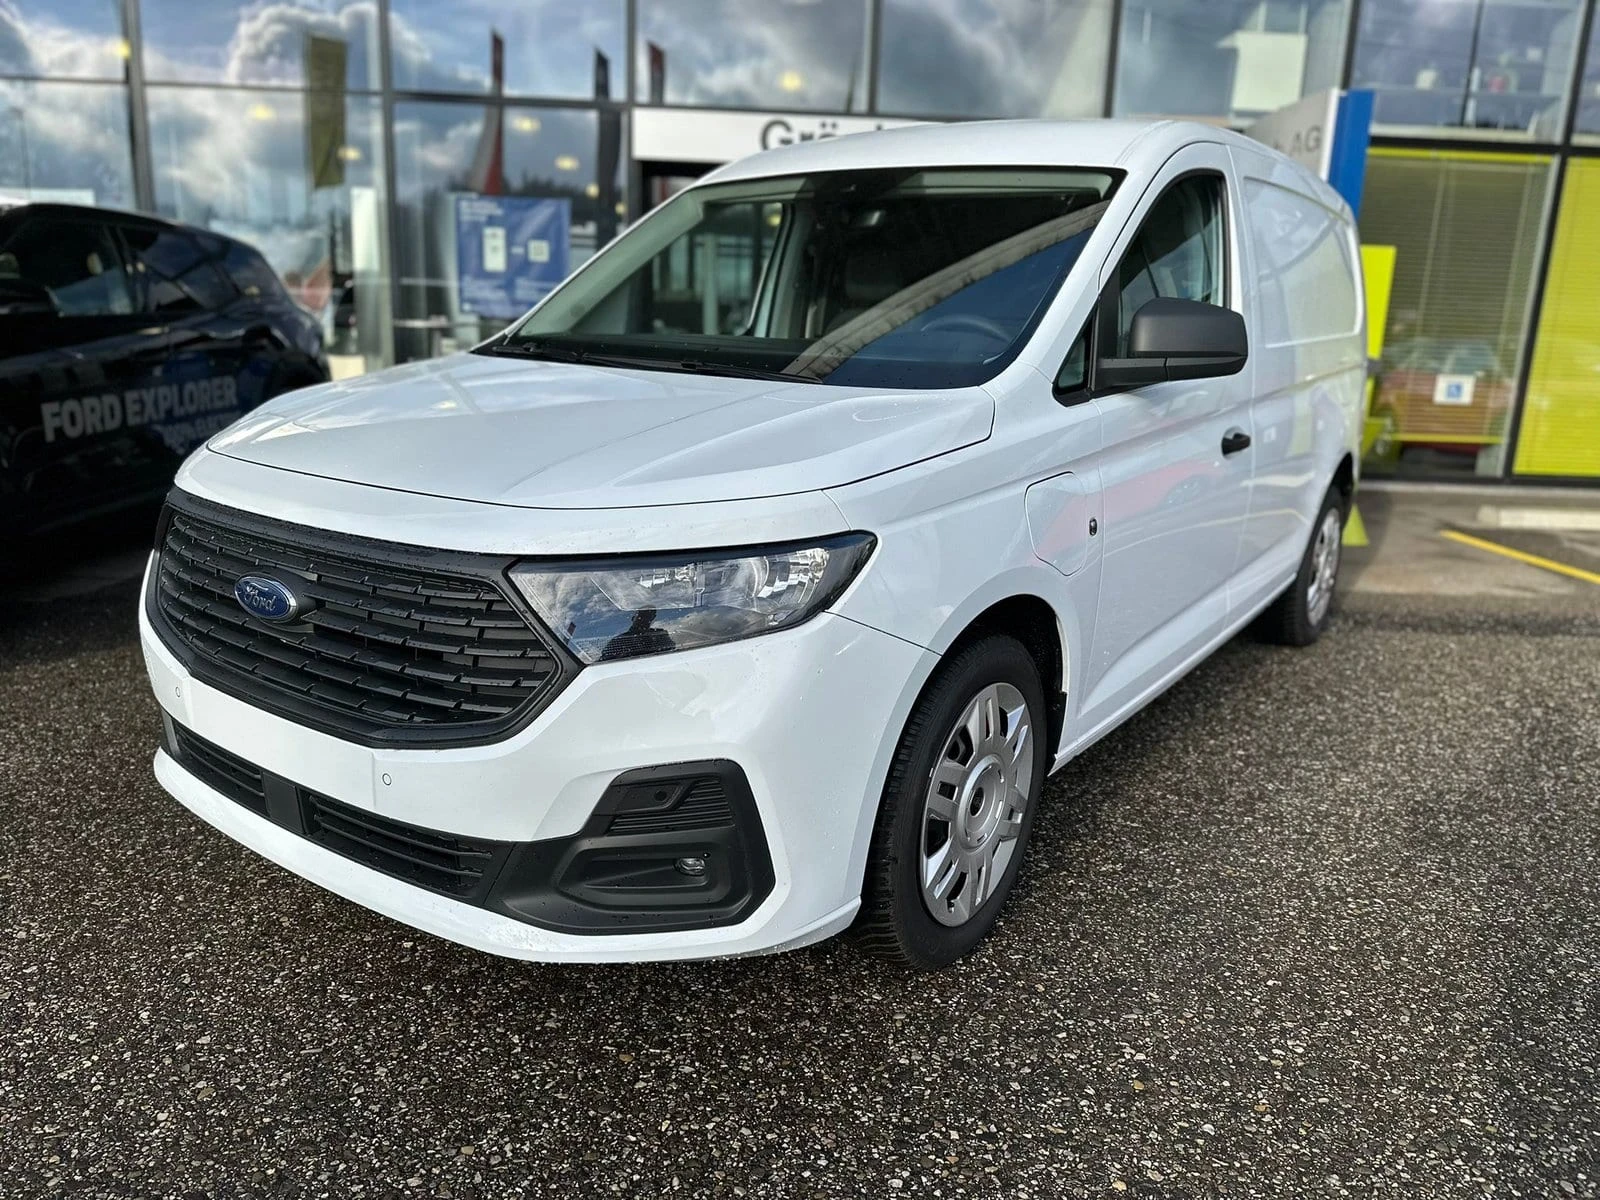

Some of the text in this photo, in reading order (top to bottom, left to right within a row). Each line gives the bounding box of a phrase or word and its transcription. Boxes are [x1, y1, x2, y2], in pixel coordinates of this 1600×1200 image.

[1289, 125, 1322, 156] AG
[41, 393, 123, 443] FORD
[124, 376, 238, 424] EXPLORER
[243, 582, 277, 611] Ford
